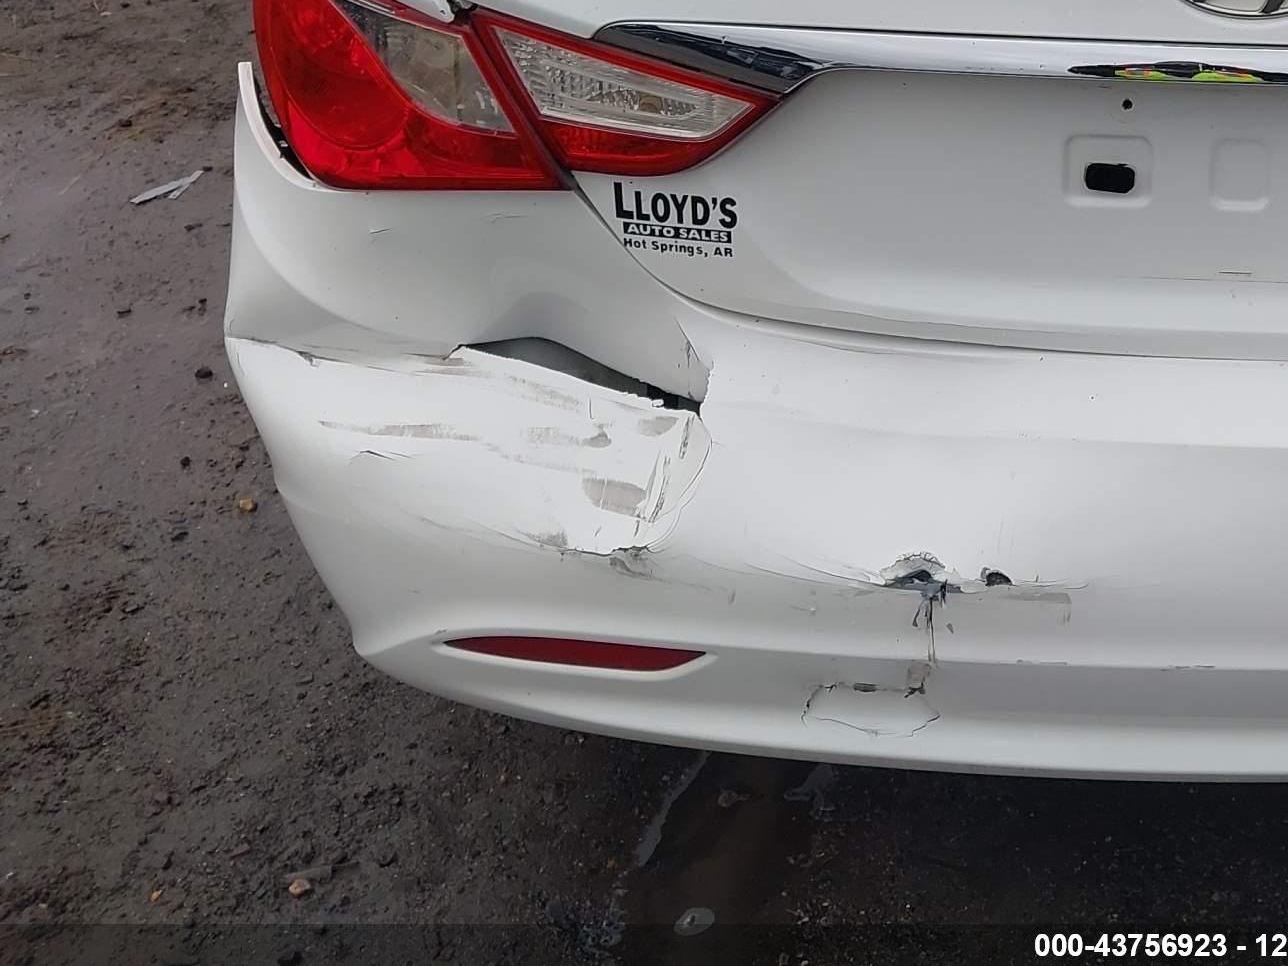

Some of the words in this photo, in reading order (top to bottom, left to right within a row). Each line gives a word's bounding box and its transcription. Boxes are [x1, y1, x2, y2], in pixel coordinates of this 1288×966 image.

[627, 223, 675, 237] AUTO
[679, 228, 729, 242] SALES
[623, 238, 648, 249] Hot
[651, 240, 708, 257] Springs,
[714, 247, 733, 257] AR
